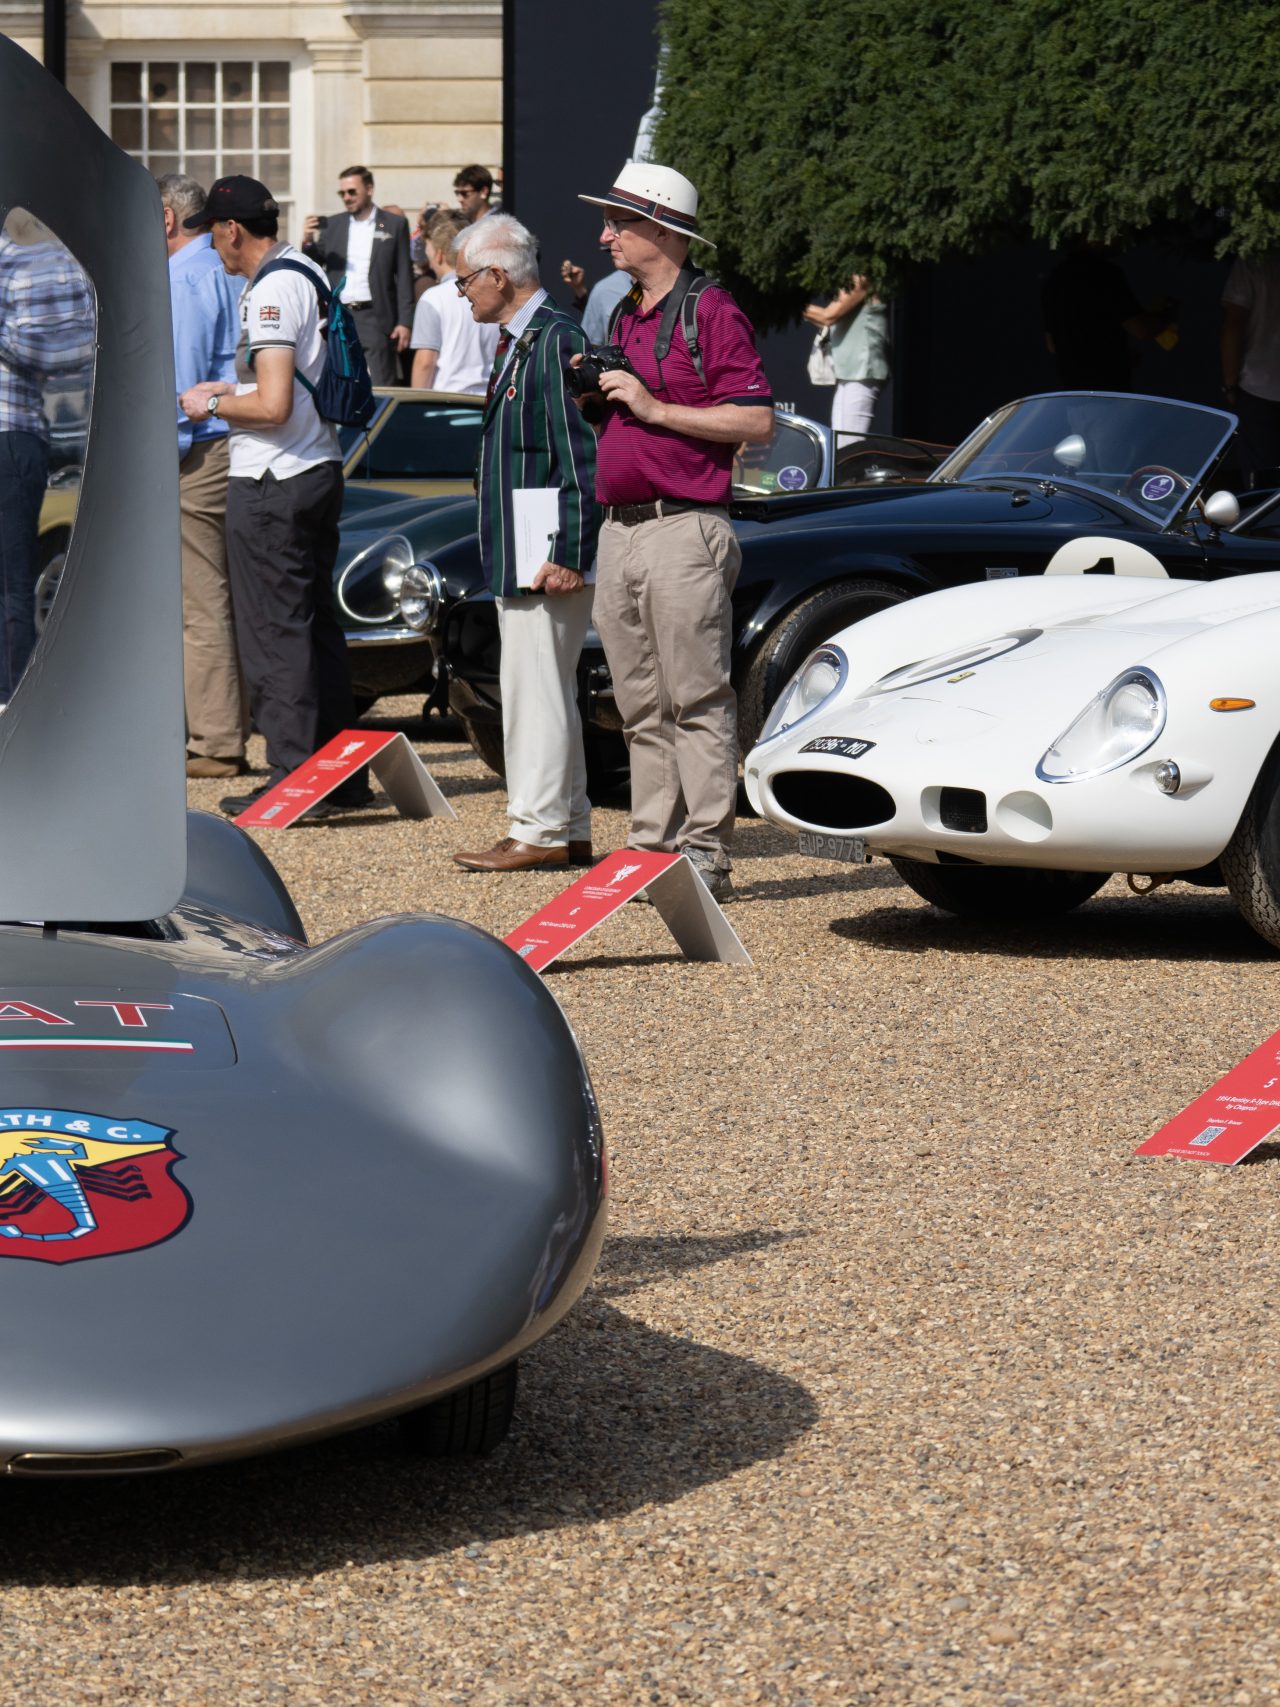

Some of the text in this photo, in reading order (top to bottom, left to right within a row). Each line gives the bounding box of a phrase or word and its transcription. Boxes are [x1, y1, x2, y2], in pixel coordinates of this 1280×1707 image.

[800, 833, 865, 862] EUP 977B
[569, 906, 581, 916] 6
[1263, 1078, 1278, 1088] 5
[64, 1121, 92, 1134] &
[106, 1127, 142, 1139] C.
